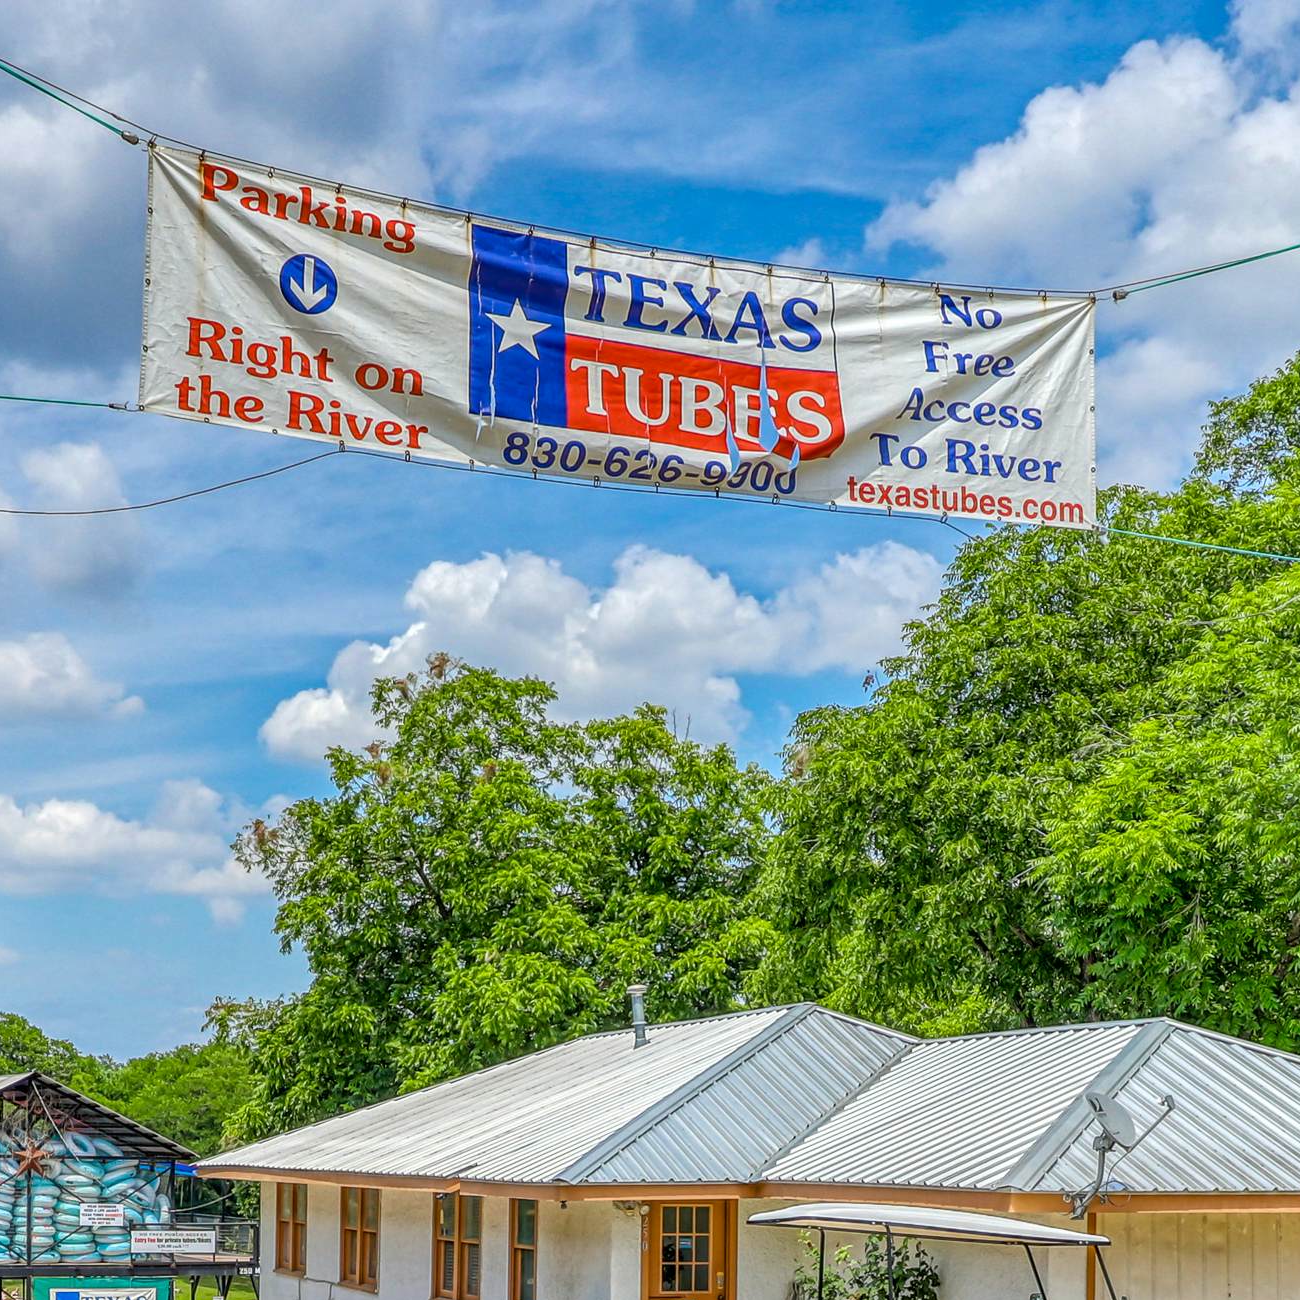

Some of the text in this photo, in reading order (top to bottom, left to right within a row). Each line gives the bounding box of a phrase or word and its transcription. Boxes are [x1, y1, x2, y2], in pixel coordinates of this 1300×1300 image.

[200, 162, 416, 254] Parking
[574, 265, 823, 353] TEXAS
[938, 294, 1002, 329] No
[185, 317, 424, 397] Right on
[922, 340, 1016, 378] Free
[175, 375, 428, 449] the River
[571, 358, 833, 445] TUBES
[896, 387, 1043, 430] Access
[503, 431, 797, 495] 830-626-9900
[869, 433, 1062, 483] To River
[847, 475, 1084, 524] texastubes.com
